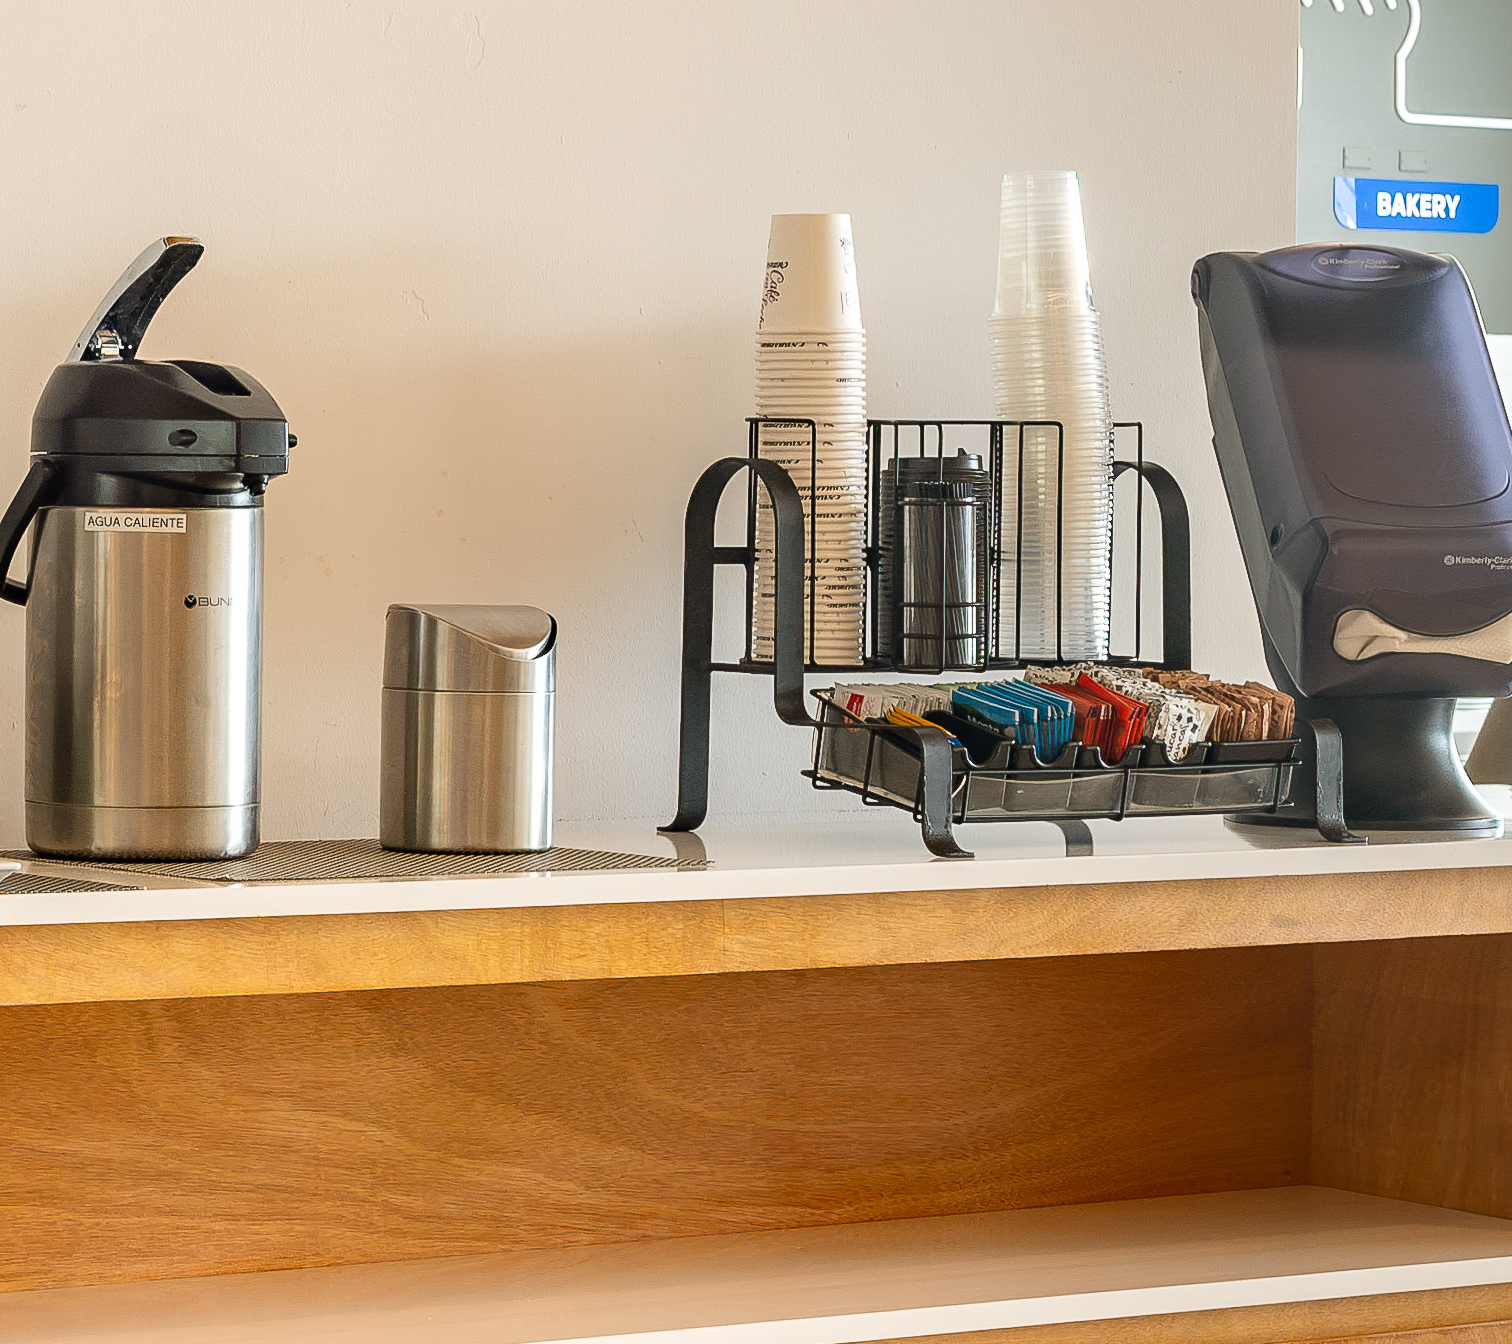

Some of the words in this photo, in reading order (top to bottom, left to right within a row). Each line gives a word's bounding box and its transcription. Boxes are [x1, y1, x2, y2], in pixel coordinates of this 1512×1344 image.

[1376, 191, 1461, 219] BAKERY
[87, 515, 121, 528] AGUA
[124, 516, 184, 529] CALIENTE
